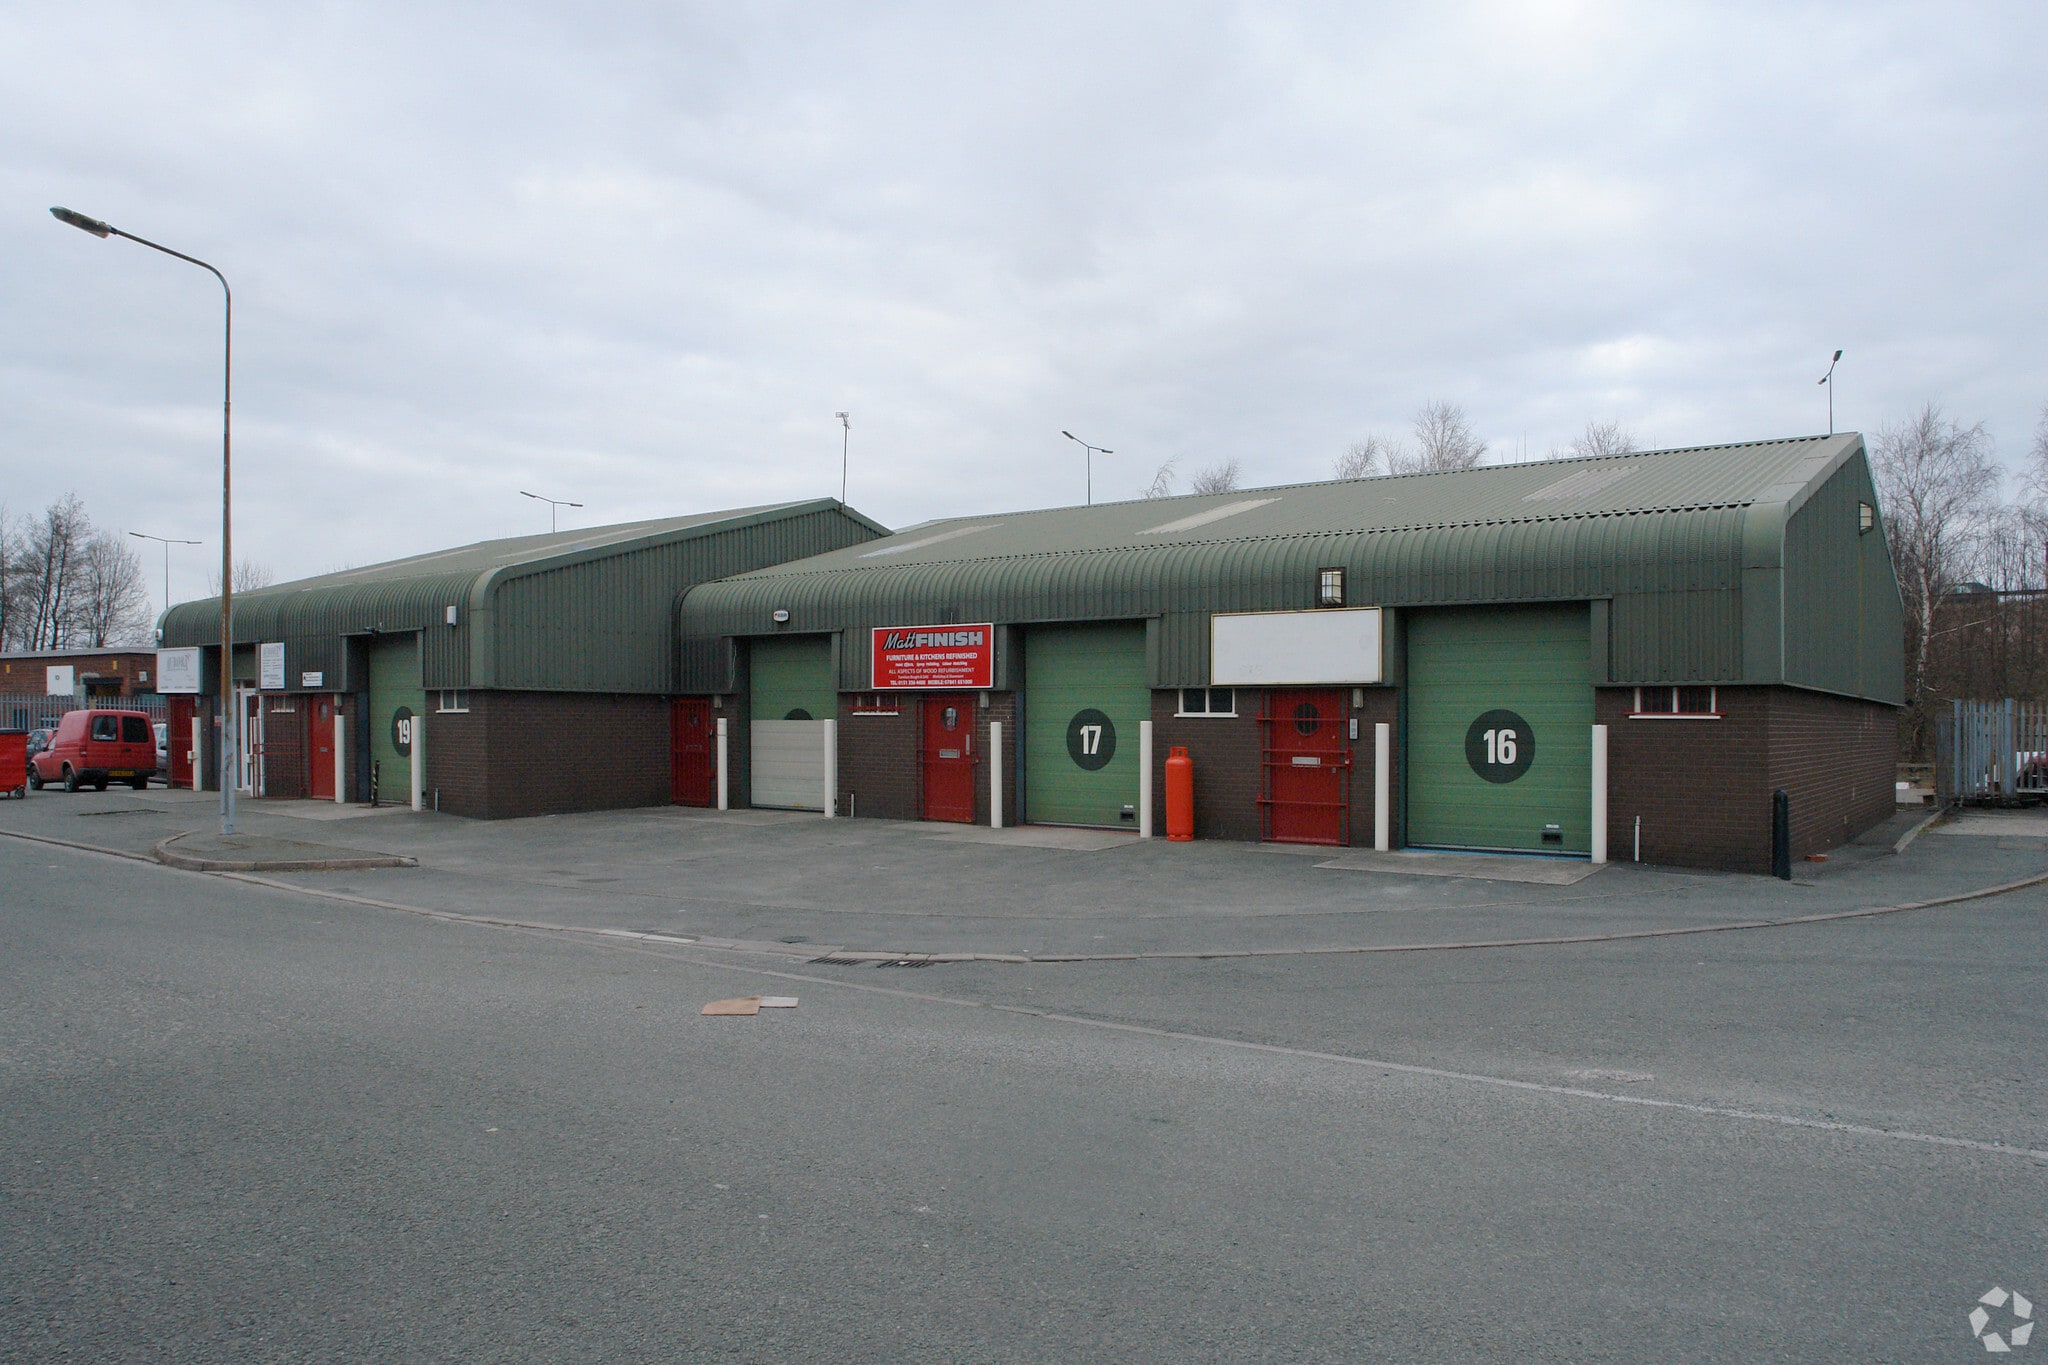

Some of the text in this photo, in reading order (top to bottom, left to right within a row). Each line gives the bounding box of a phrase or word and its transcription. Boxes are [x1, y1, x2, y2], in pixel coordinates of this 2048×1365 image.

[946, 652, 978, 660] REFINISHED
[397, 719, 410, 744] 19
[1080, 725, 1102, 755] 17
[1483, 728, 1517, 765] 16
